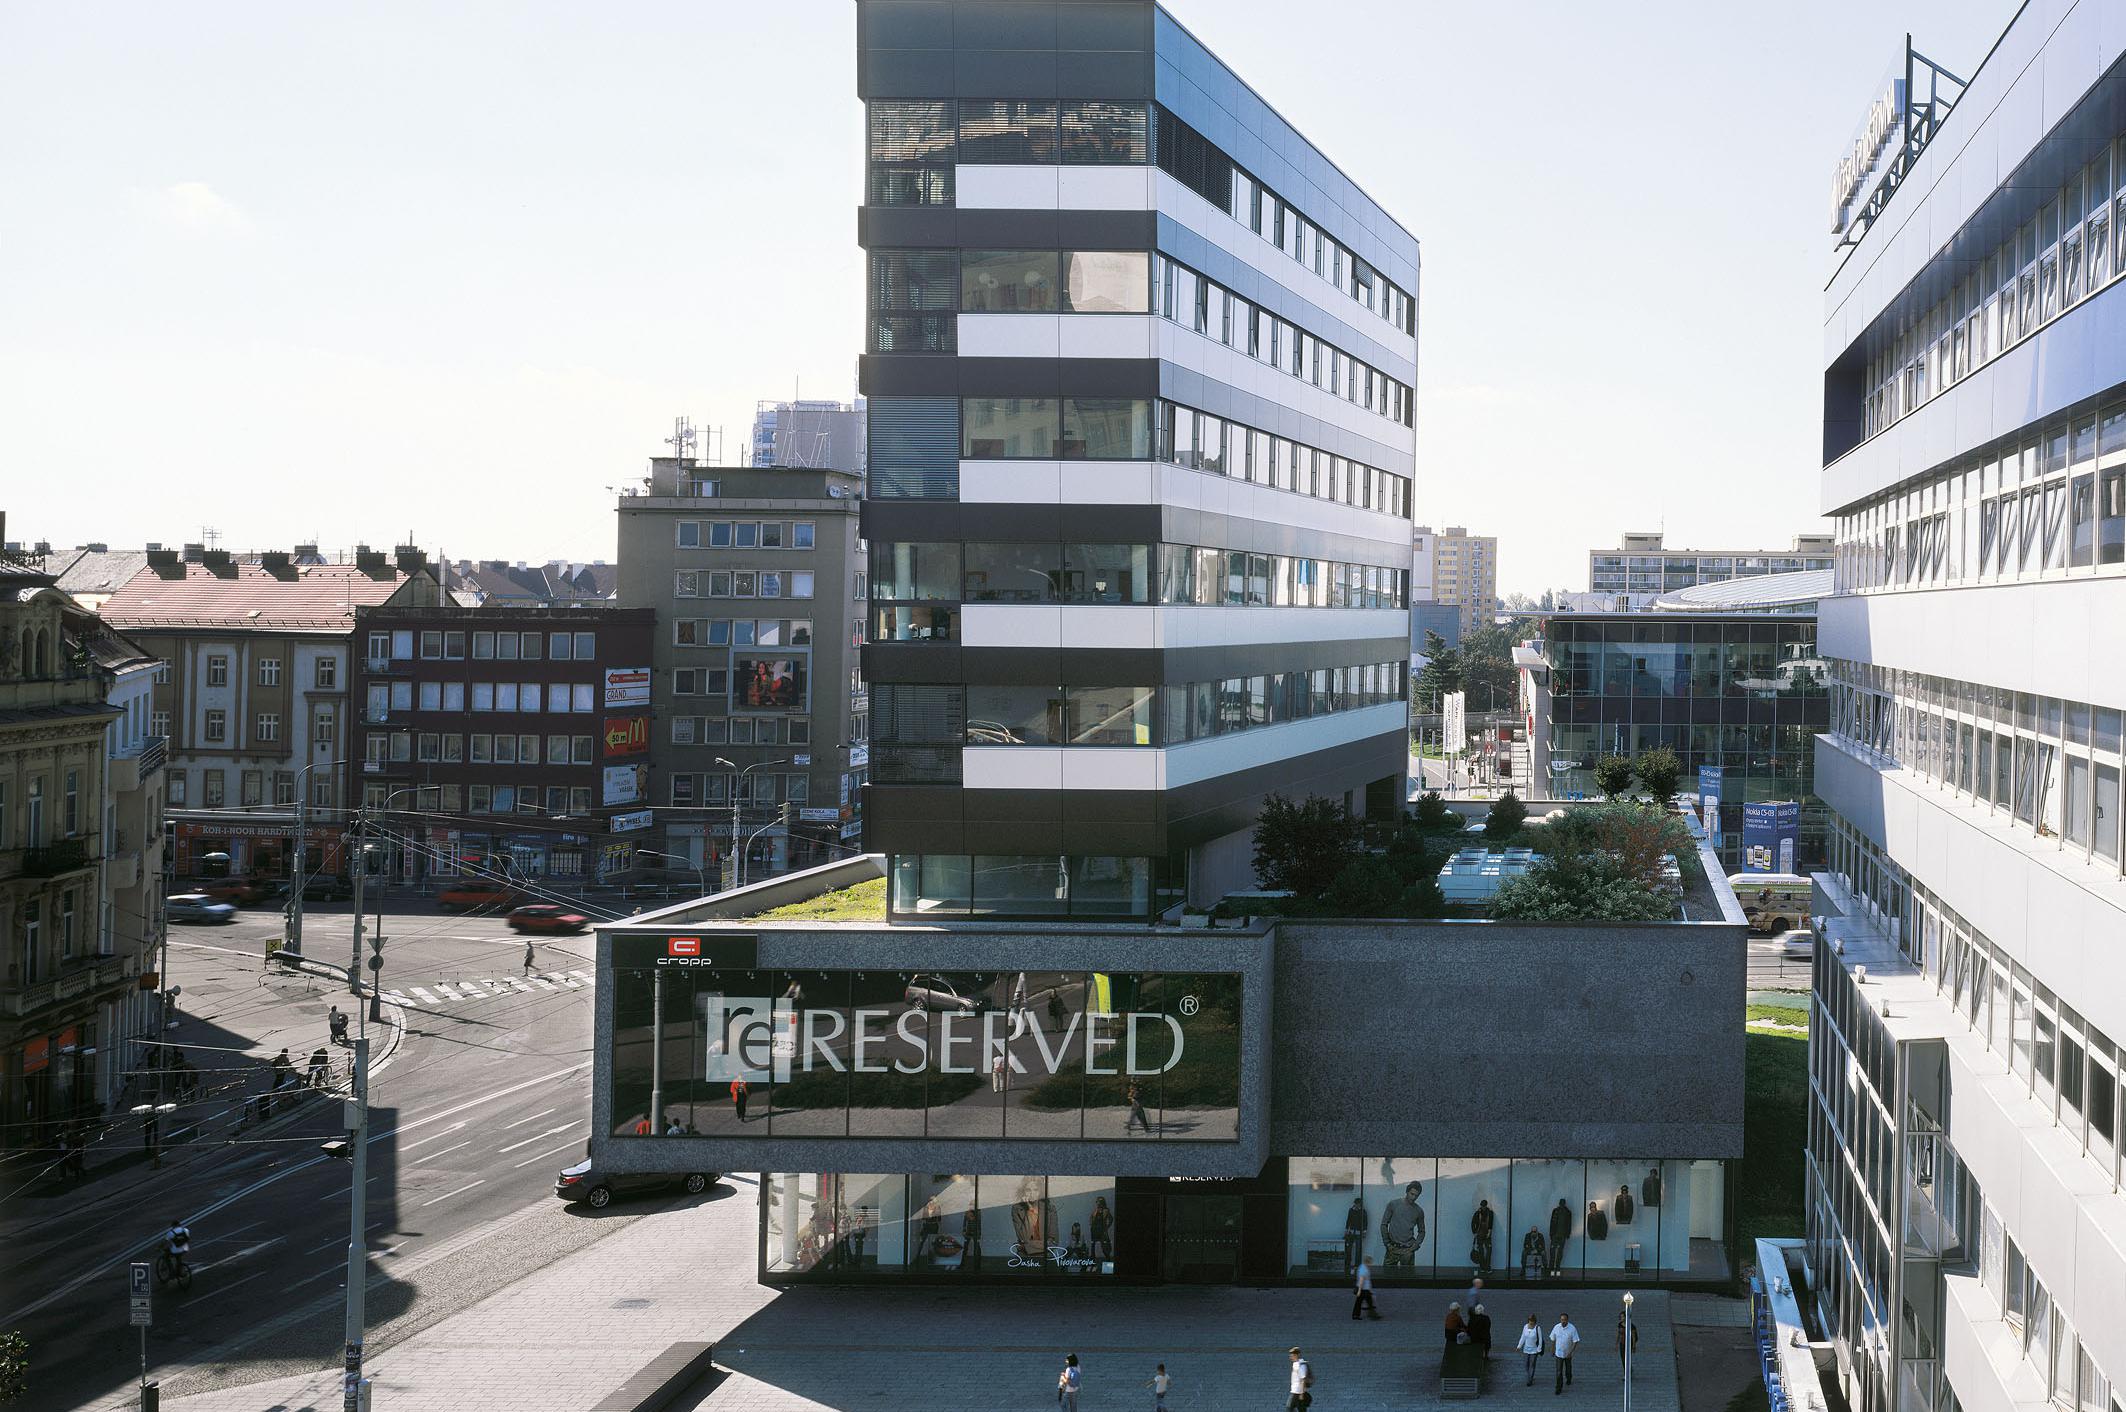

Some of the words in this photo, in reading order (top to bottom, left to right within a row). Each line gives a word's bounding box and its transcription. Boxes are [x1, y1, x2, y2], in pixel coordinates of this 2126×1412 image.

[1745, 807, 1760, 816] Nokia
[202, 826, 255, 835] KOH-I-NOOR
[656, 957, 712, 967] cropp
[801, 1008, 1185, 1075] RESERVED
[1007, 1243, 1042, 1267] Sasha
